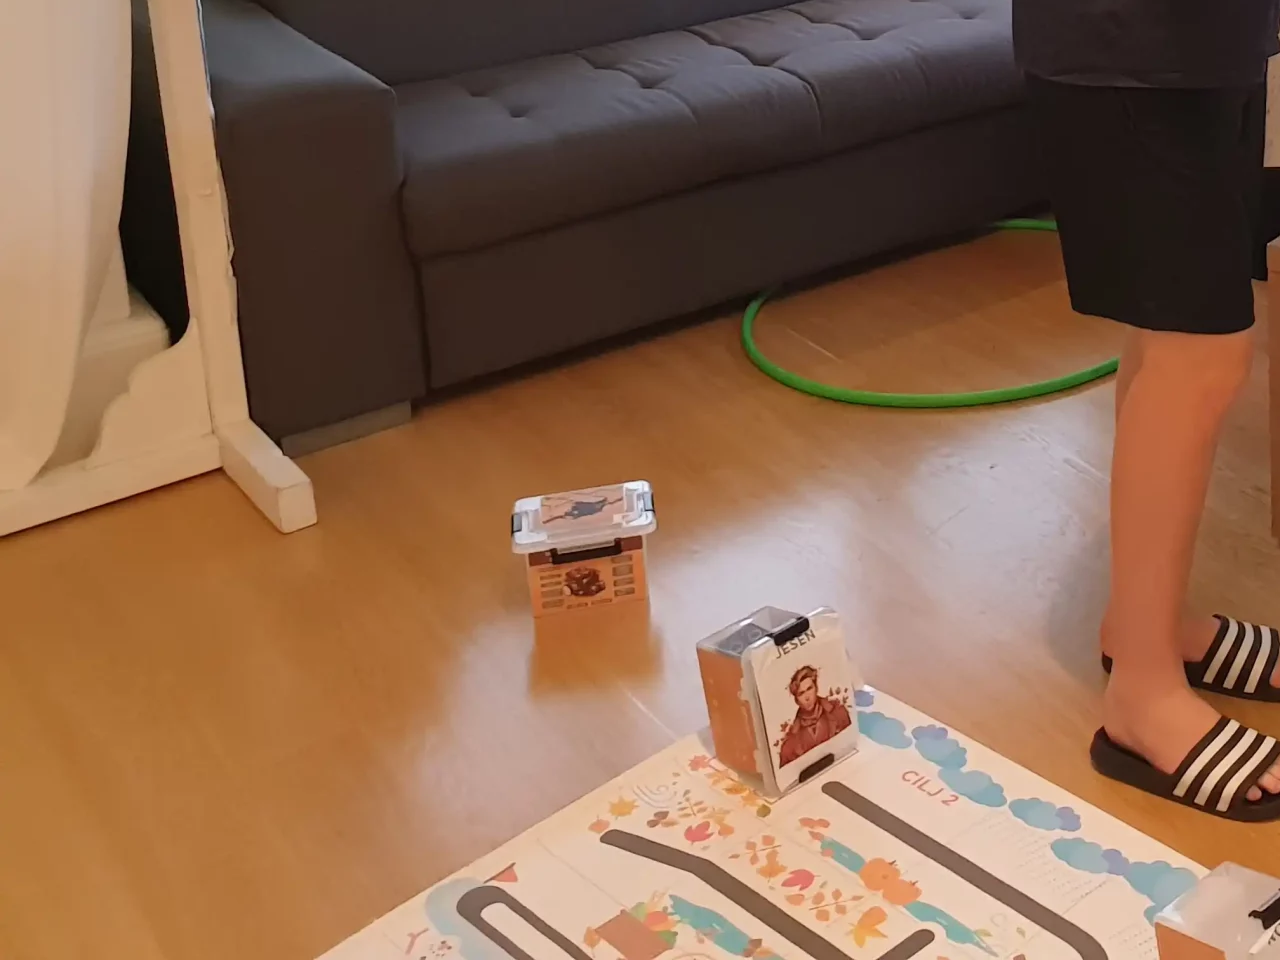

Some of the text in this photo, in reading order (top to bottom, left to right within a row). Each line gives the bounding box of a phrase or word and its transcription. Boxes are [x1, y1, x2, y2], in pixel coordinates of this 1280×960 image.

[776, 629, 816, 659] JESEN
[902, 770, 959, 807] CILJ 2
